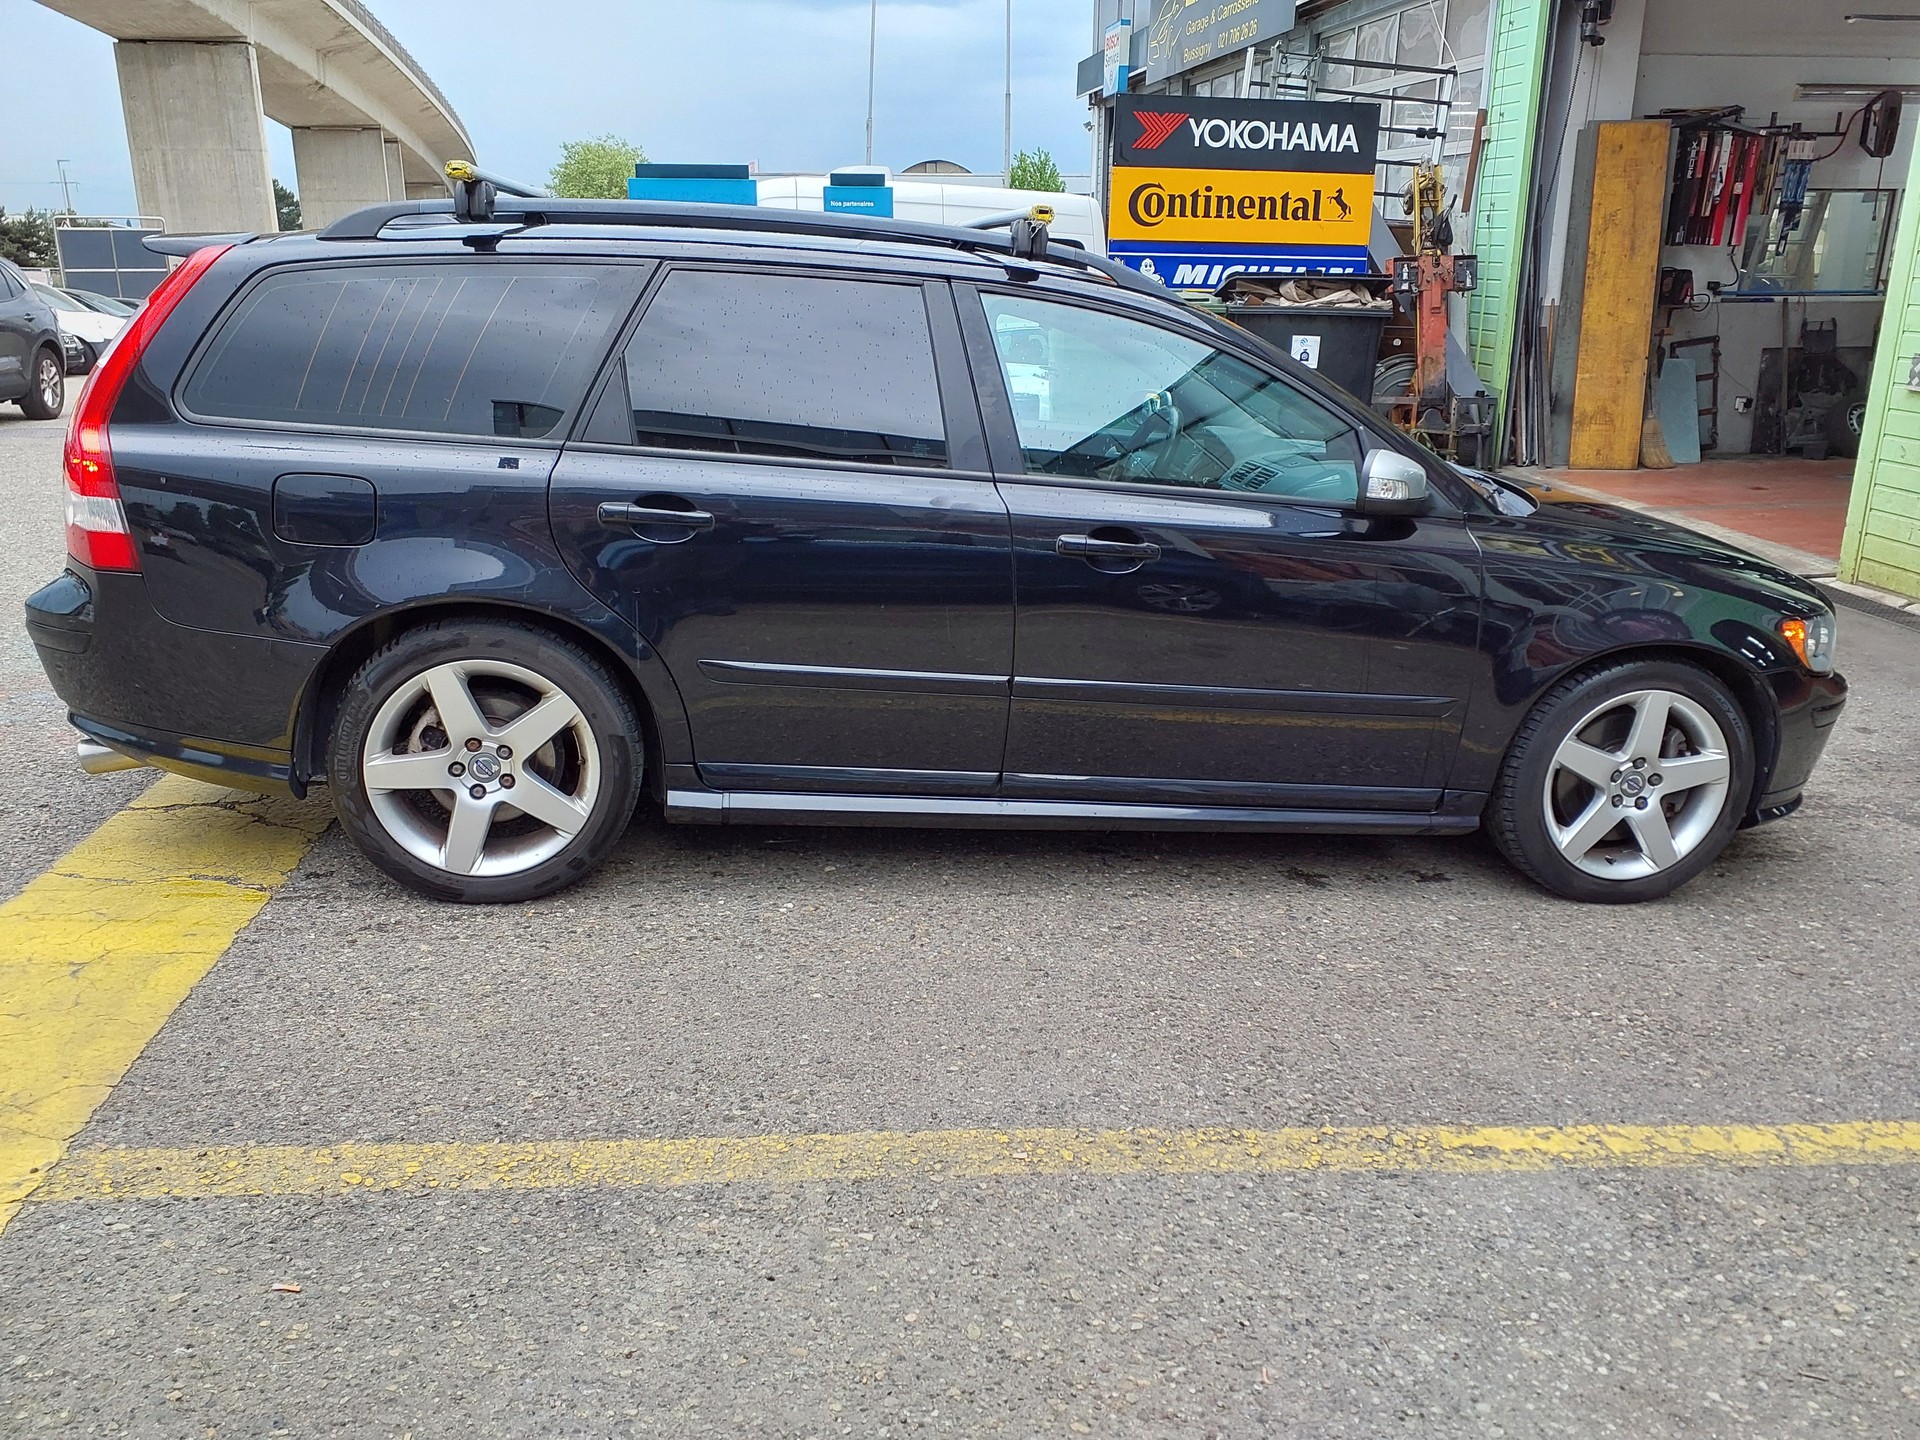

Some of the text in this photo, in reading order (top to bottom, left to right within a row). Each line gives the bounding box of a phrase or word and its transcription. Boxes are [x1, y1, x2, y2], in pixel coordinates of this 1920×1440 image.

[1185, 15, 1209, 36] Garage
[1210, 9, 1216, 24] &
[1217, 32, 1229, 49] 021
[1188, 117, 1360, 153] YOKOHAMA
[1128, 181, 1322, 227] Continental
